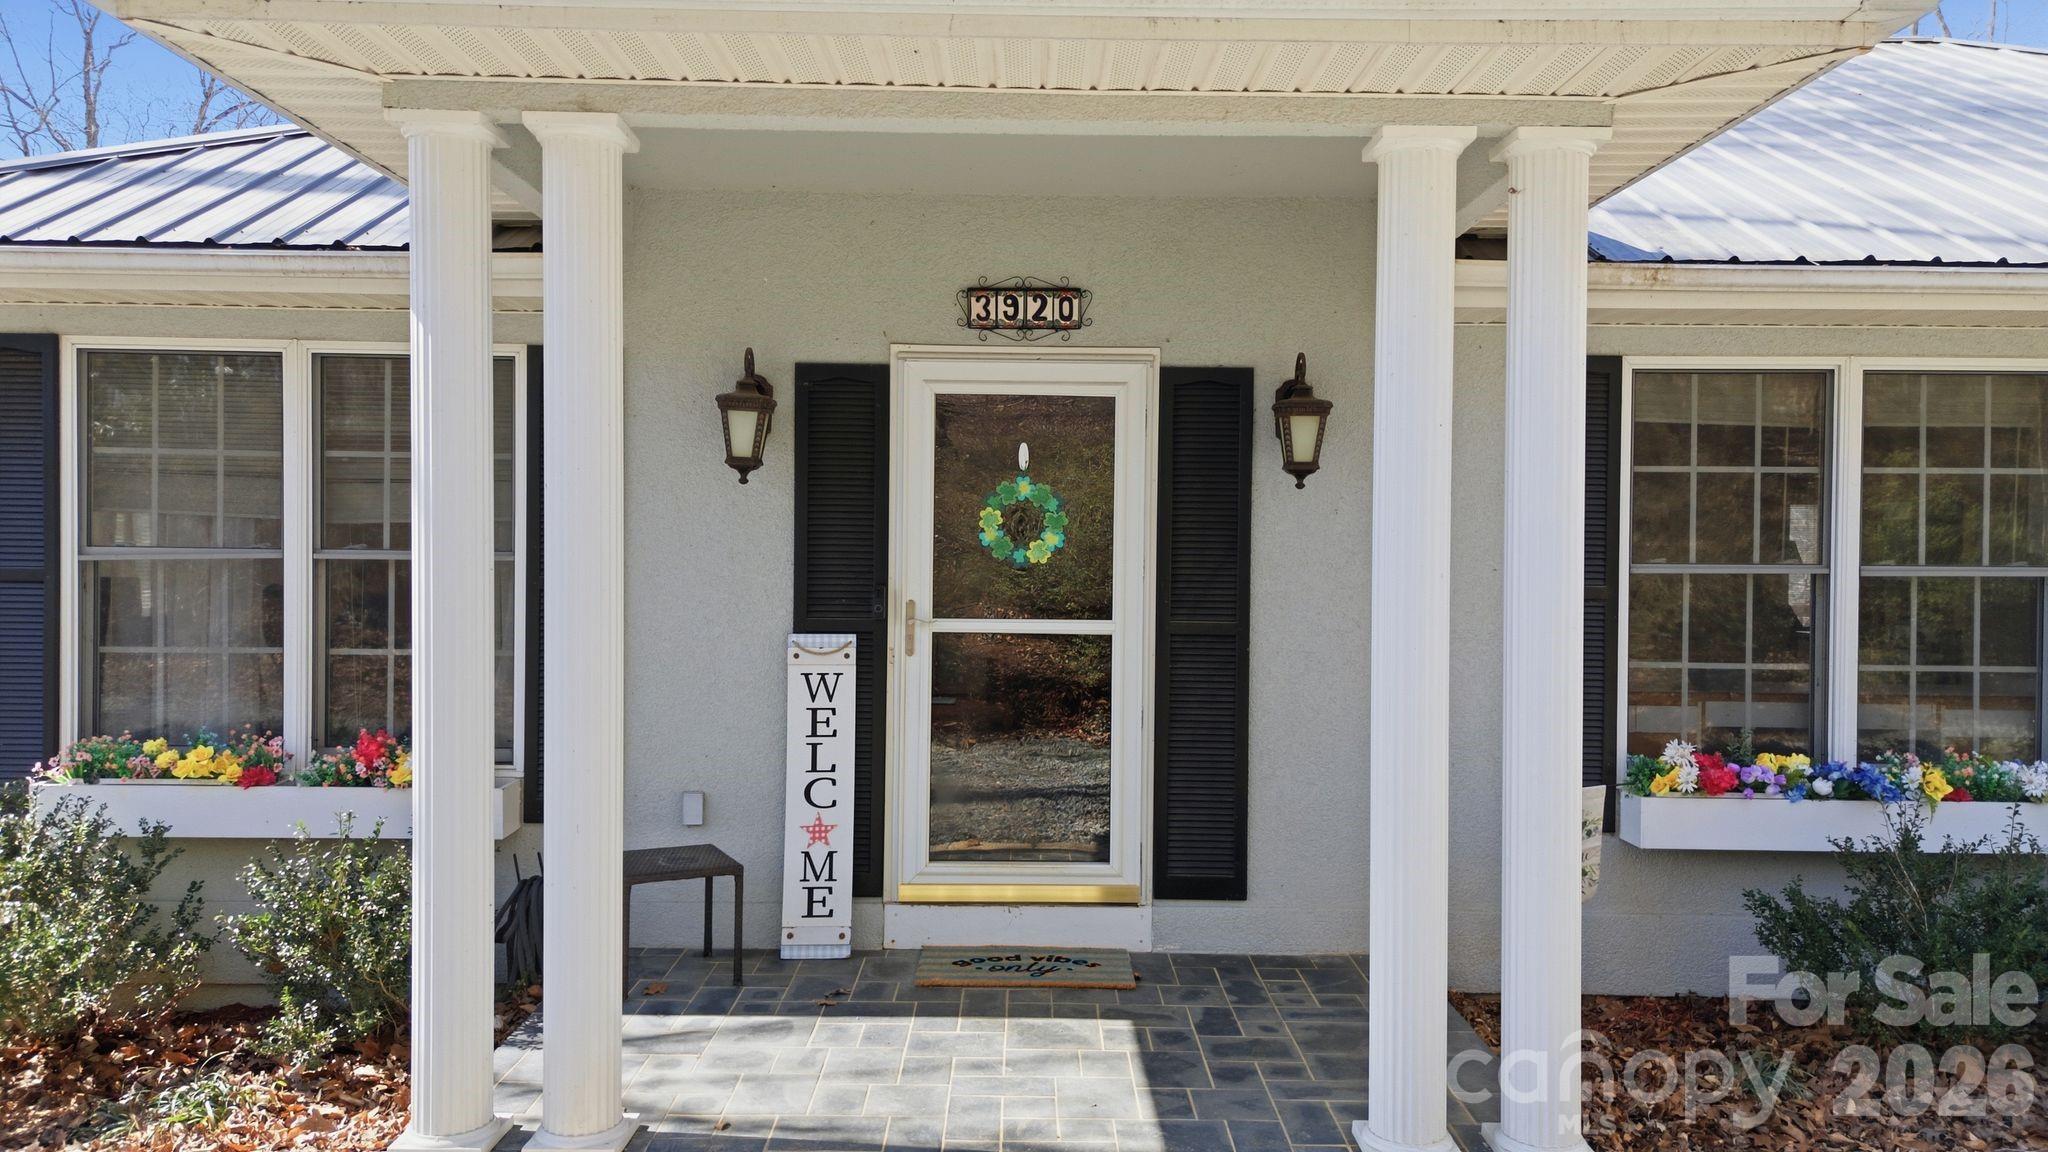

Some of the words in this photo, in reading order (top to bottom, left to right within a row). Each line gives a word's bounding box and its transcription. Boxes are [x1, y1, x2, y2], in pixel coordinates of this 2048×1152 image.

[975, 294, 1074, 322] 3920
[799, 672, 843, 918] WELCME
[951, 954, 1021, 967] good
[1030, 954, 1102, 968] vibes
[982, 961, 1061, 977] only
